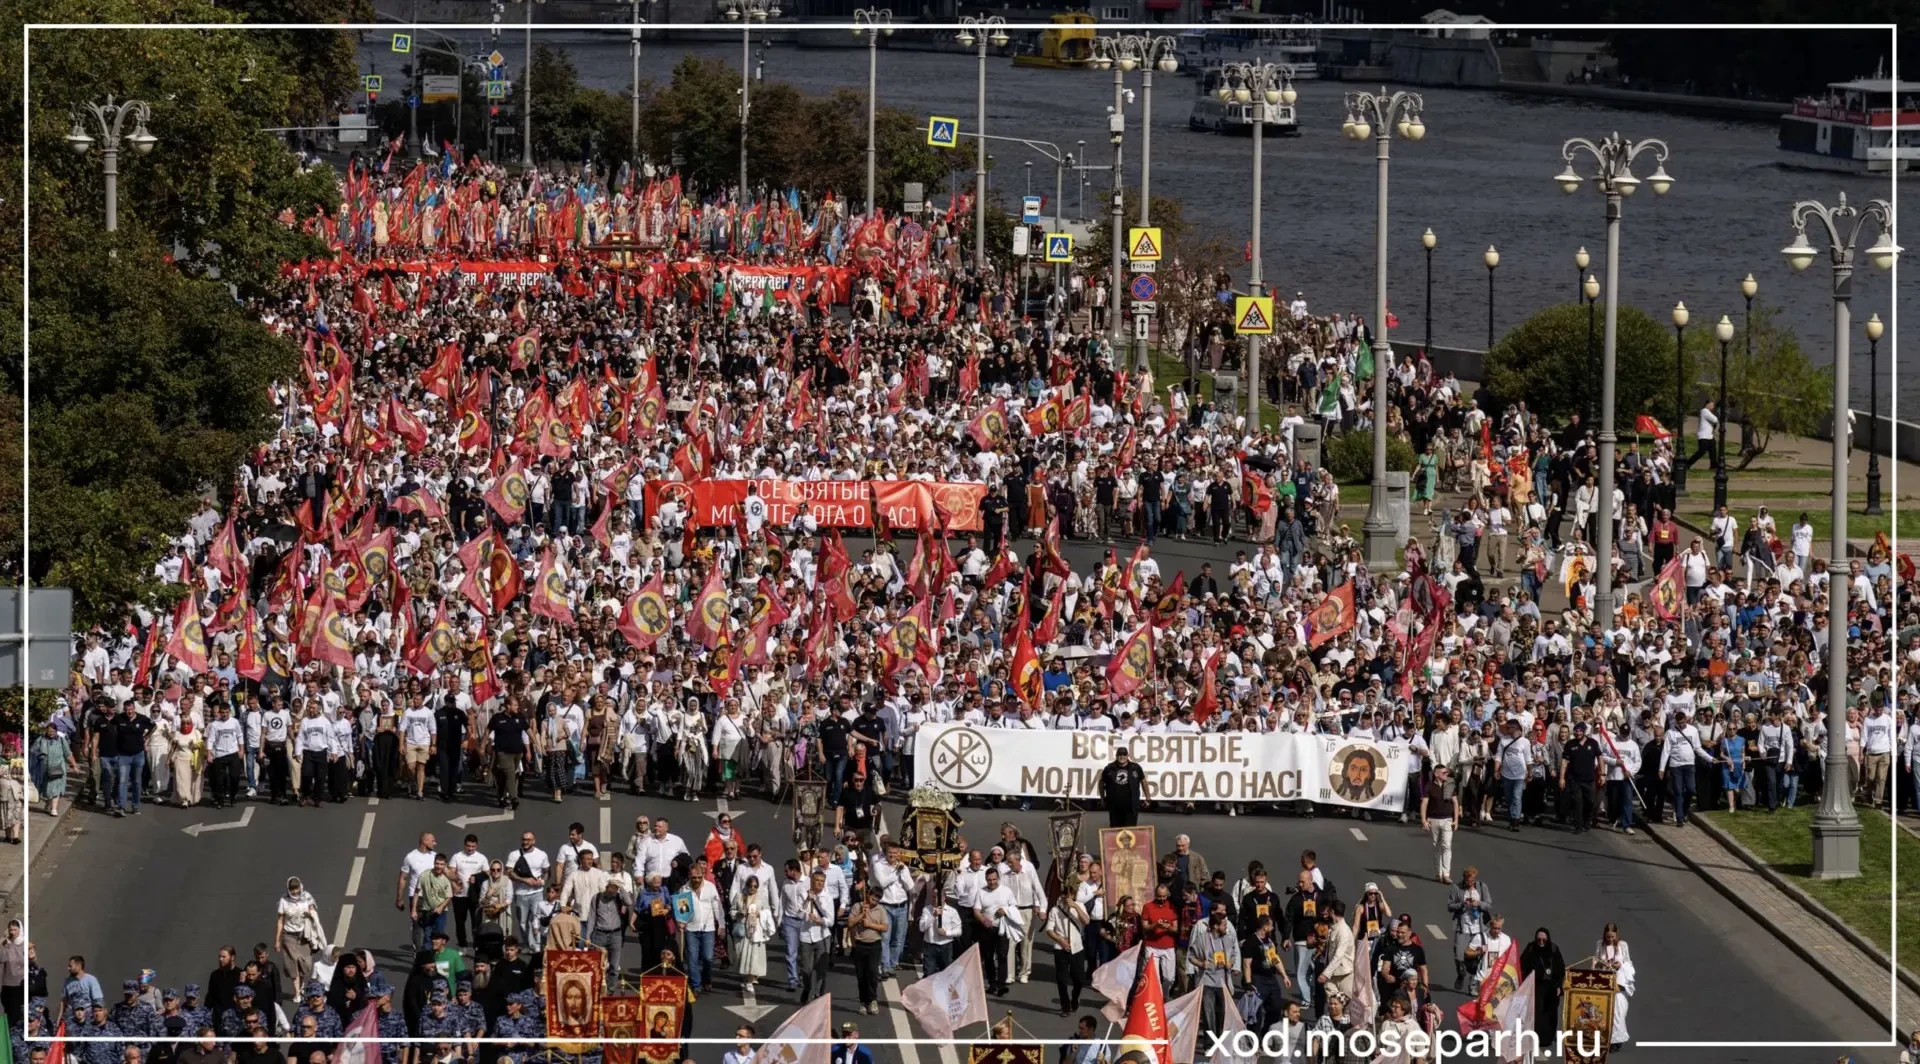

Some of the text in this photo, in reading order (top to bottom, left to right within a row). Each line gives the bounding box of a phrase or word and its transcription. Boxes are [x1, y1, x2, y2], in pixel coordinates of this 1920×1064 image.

[790, 481, 870, 501] СВЯТЫЕ
[853, 504, 865, 526] О
[1128, 734, 1250, 768] СВЯТЫЕ,
[1215, 770, 1233, 799] О
[1240, 770, 1303, 799] НАС!
